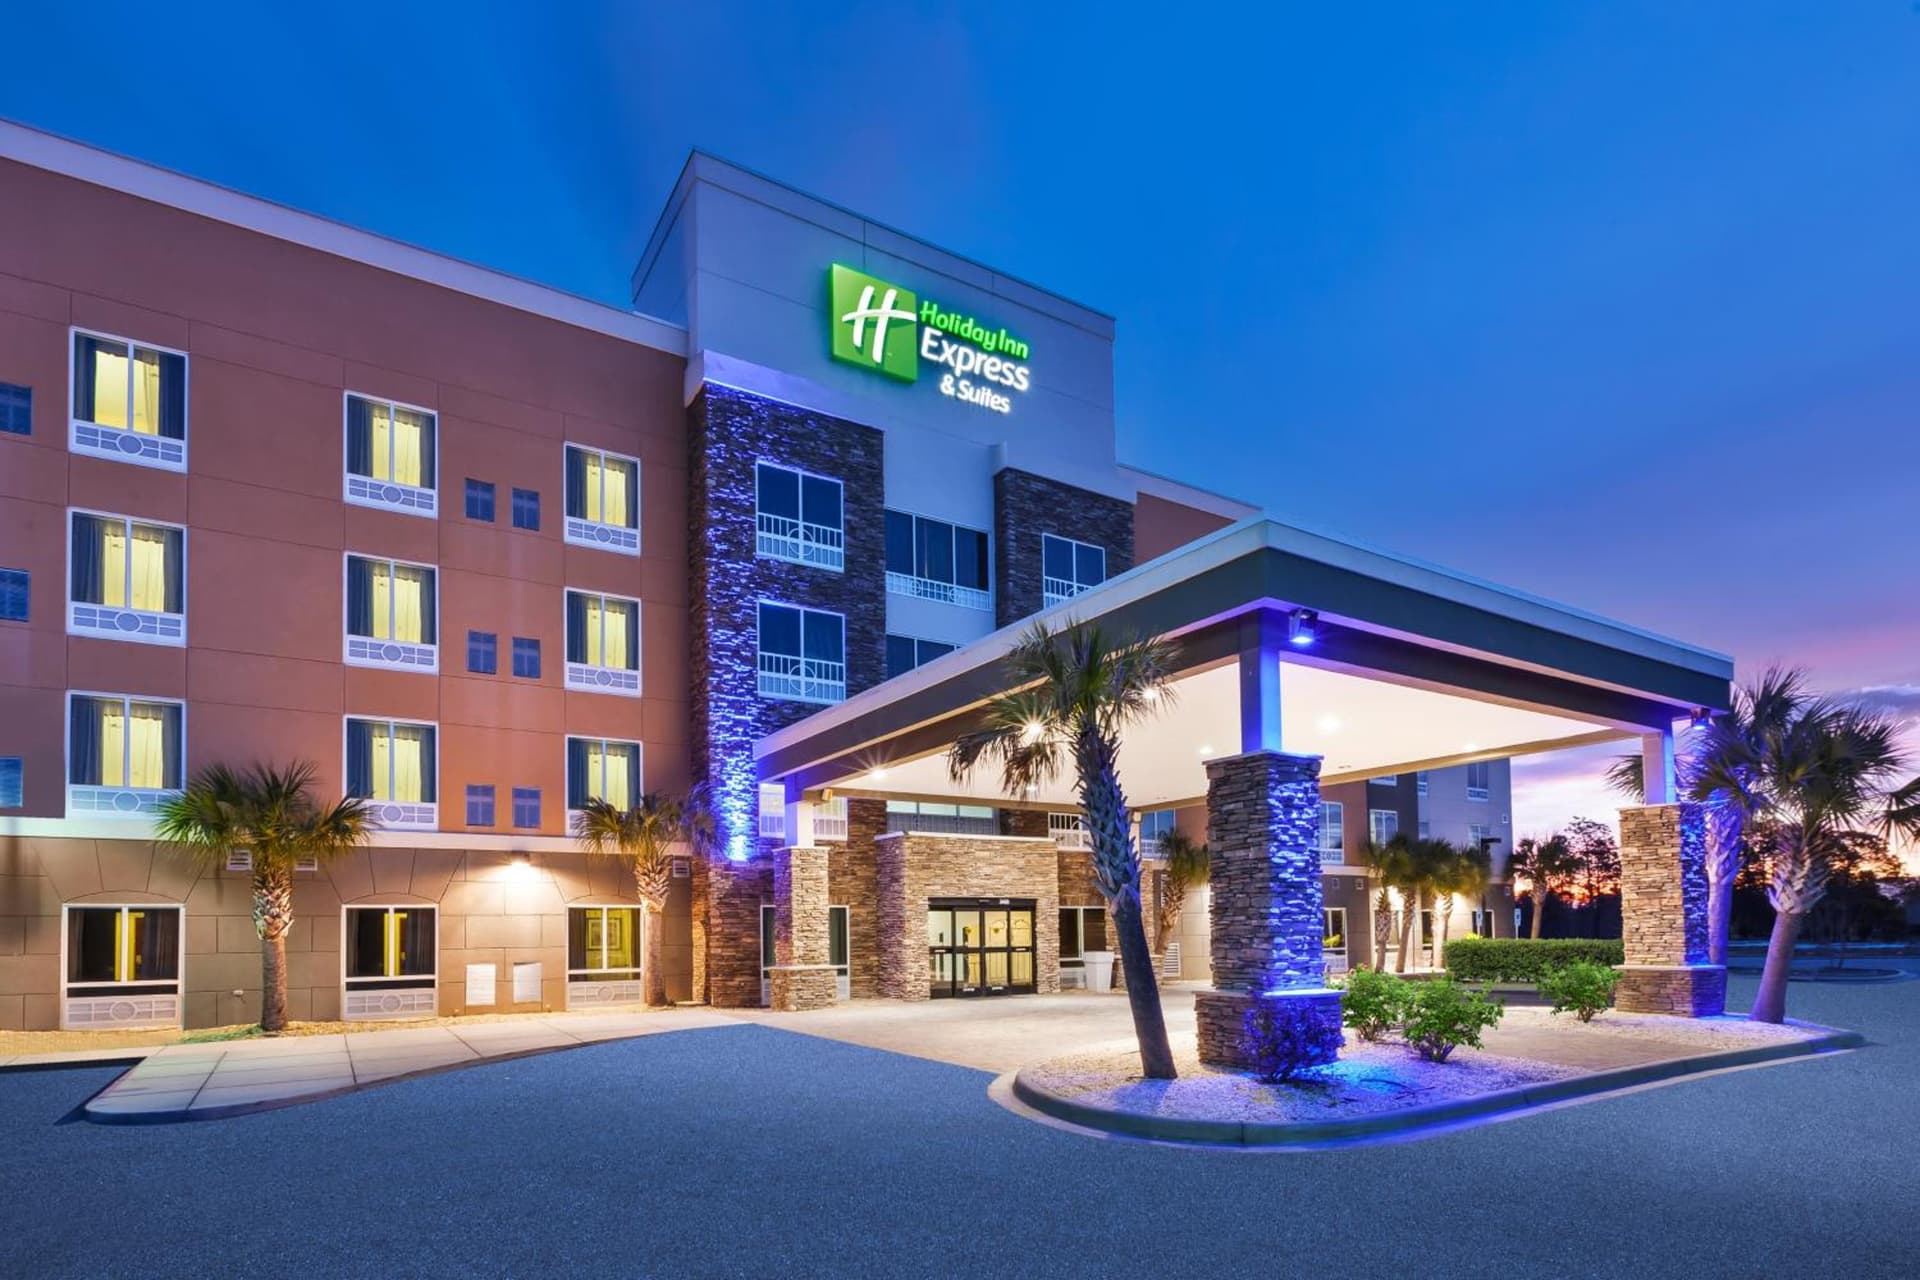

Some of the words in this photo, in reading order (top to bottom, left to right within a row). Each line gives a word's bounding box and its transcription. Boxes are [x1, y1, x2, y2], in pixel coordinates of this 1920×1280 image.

[842, 286, 917, 363] H
[920, 301, 996, 350] Holiday
[1000, 329, 1028, 359] Inn
[920, 327, 1029, 391] Express
[940, 374, 956, 396] &
[957, 380, 1011, 413] Suites
